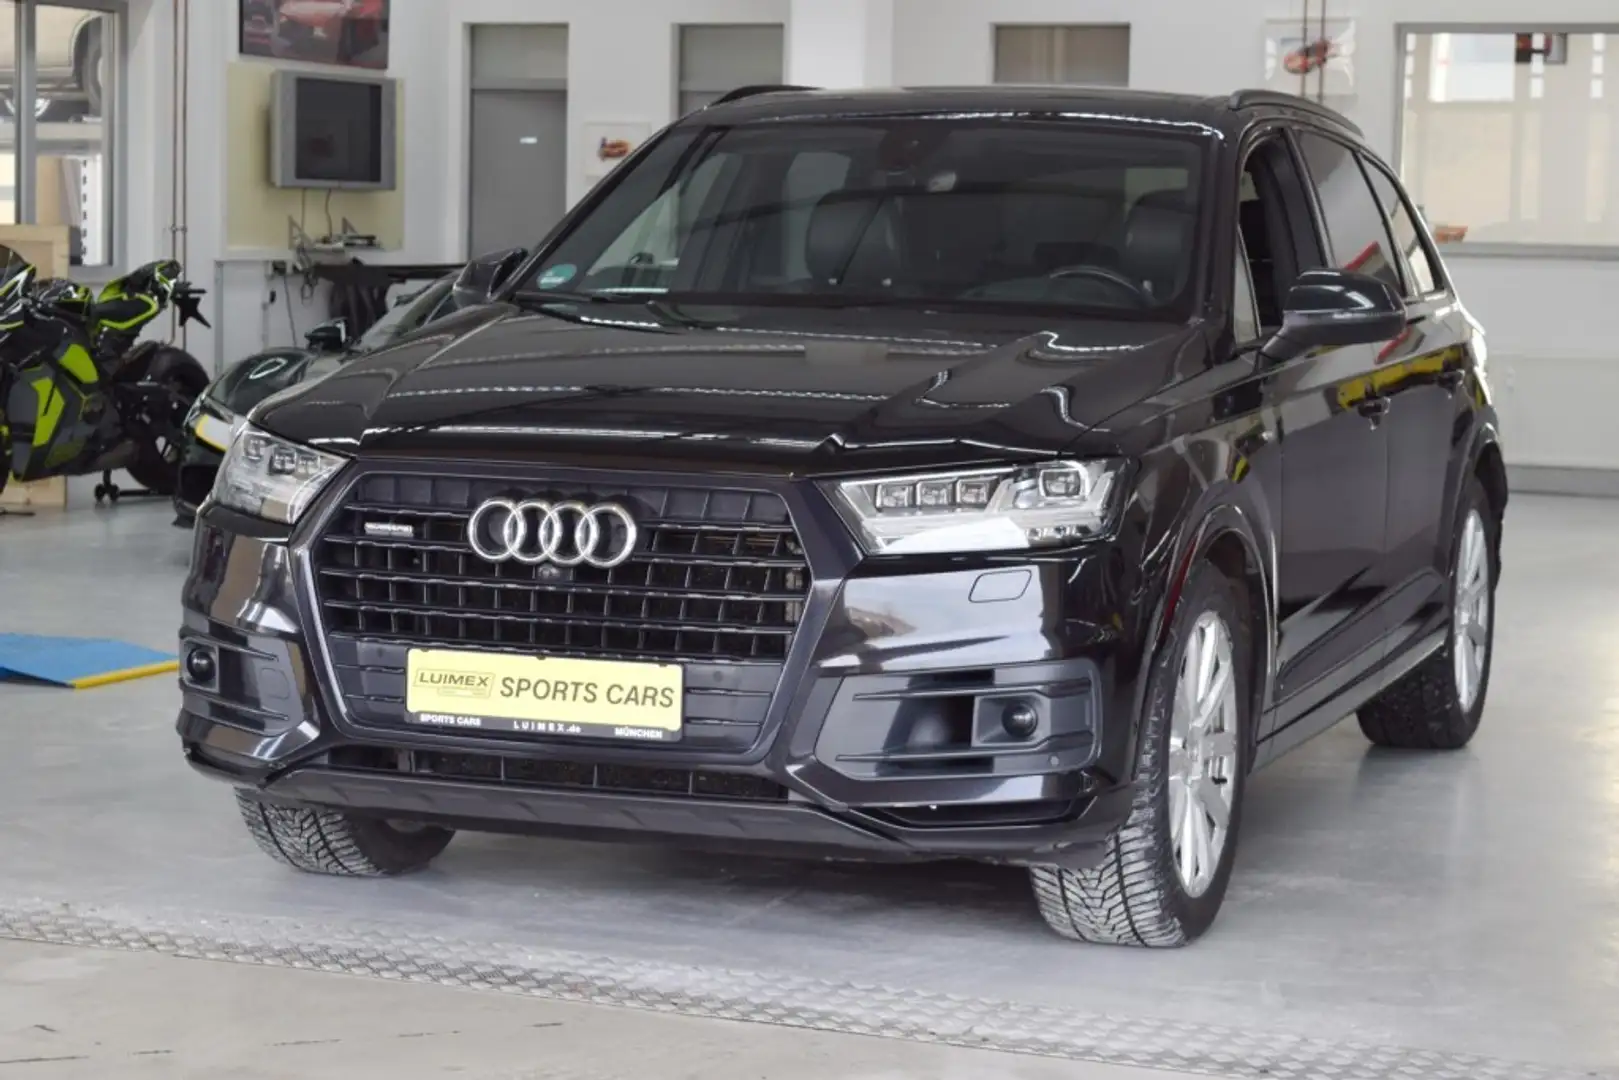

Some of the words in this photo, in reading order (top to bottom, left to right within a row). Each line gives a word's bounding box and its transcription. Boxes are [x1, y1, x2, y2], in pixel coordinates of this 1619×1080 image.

[419, 671, 489, 687] LUIMEX
[500, 676, 598, 704] SPORTS
[606, 684, 675, 709] CARS
[420, 713, 455, 725] SPORTS
[456, 716, 481, 727] CARS
